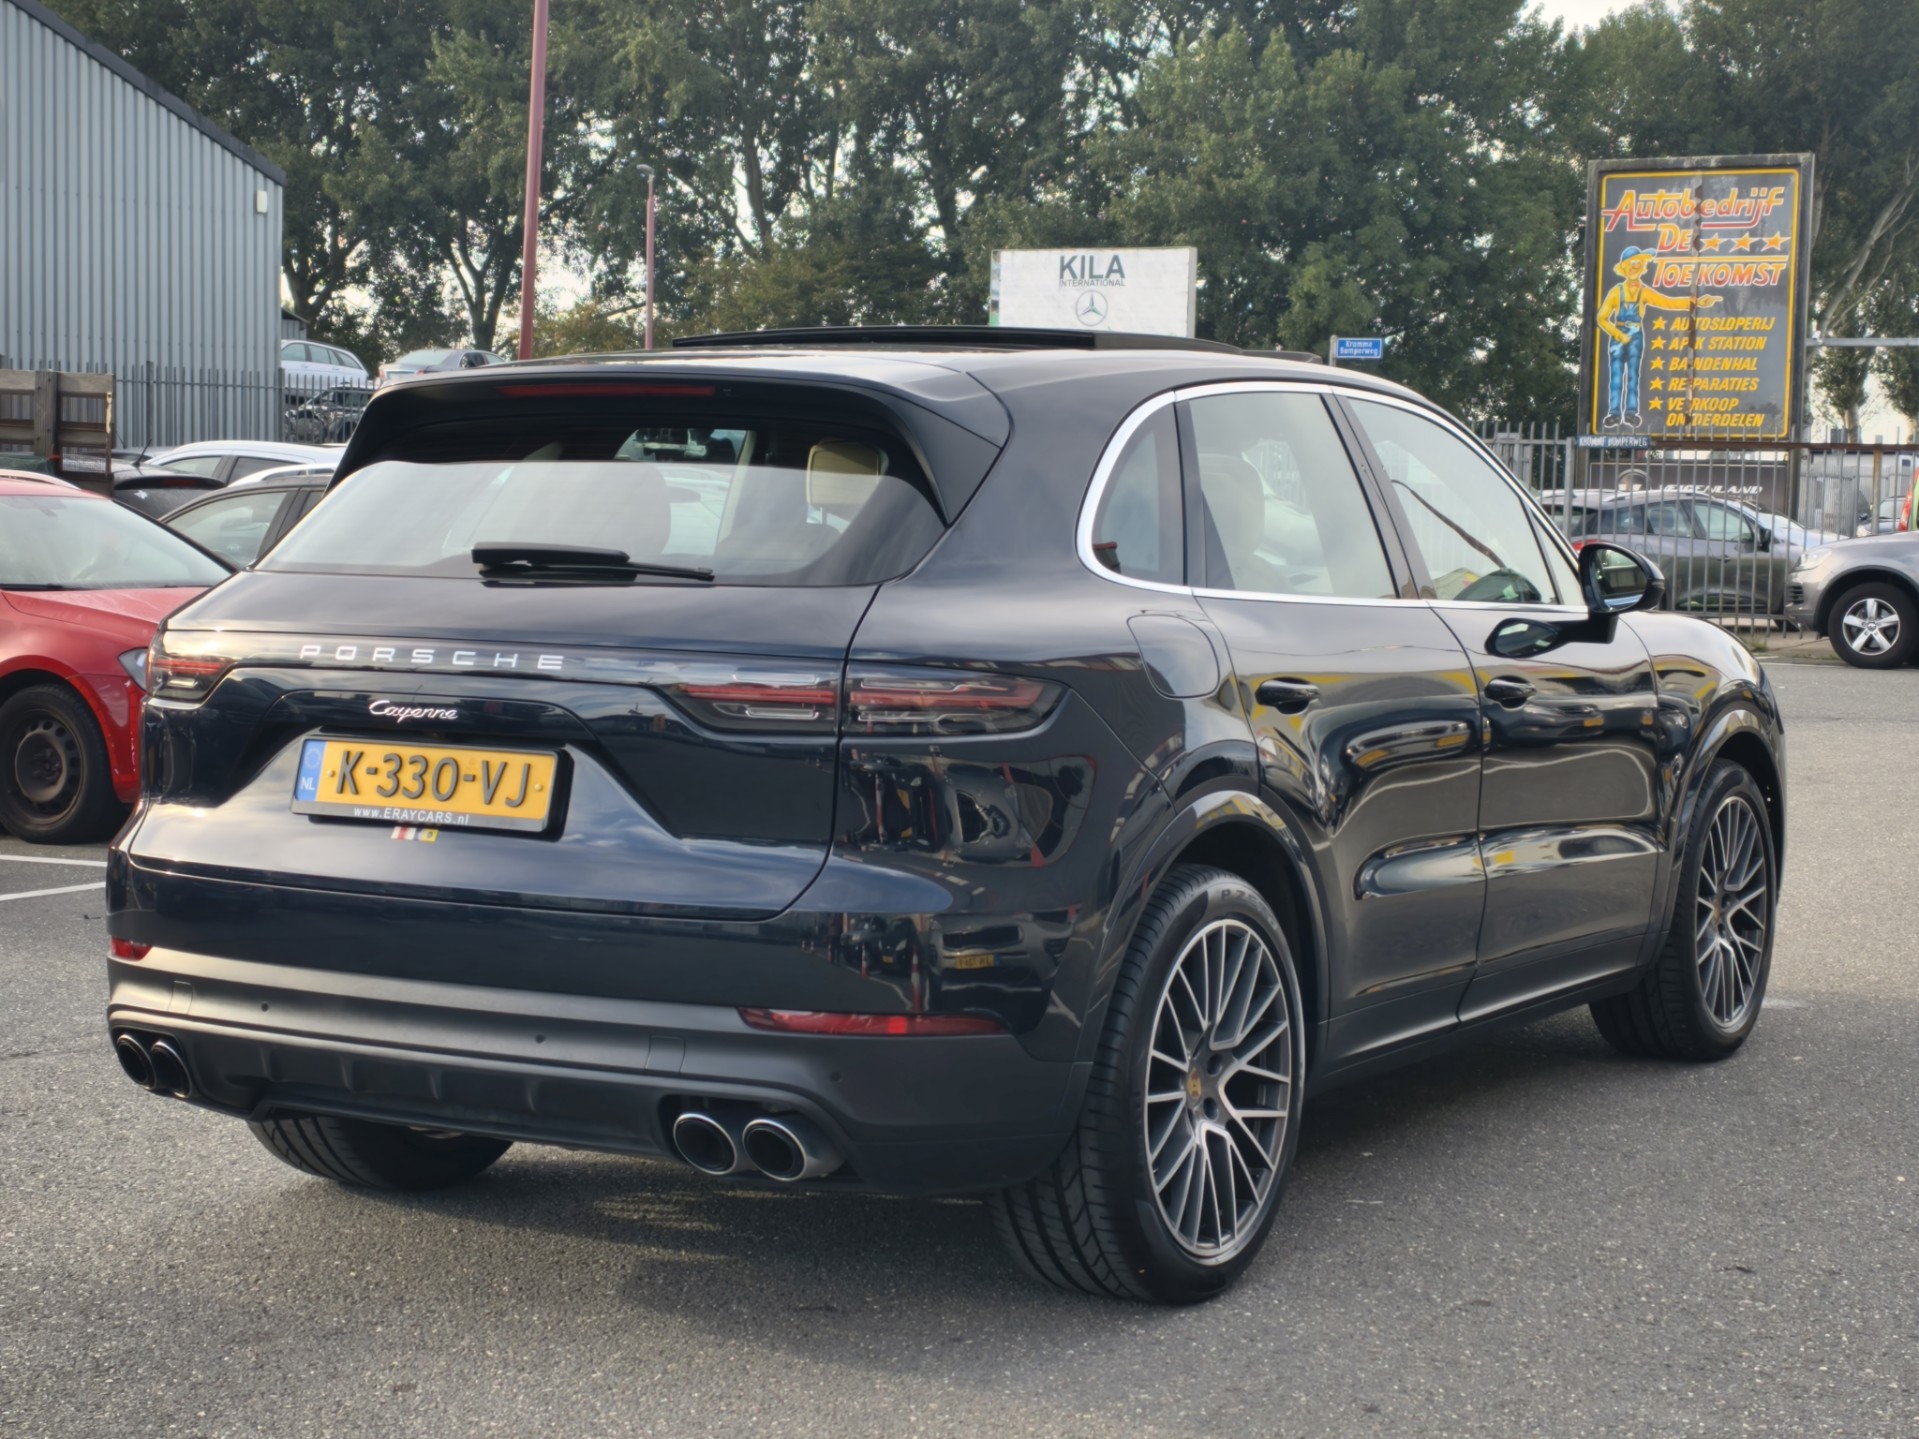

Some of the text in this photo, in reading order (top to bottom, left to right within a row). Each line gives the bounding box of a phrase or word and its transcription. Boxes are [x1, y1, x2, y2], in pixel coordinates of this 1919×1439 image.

[1601, 187, 1784, 232] Autobedrijf
[1059, 254, 1126, 280] KILA
[1652, 255, 1789, 288] TOEKOMST
[1059, 278, 1126, 288] INTERNATIONAL
[1670, 316, 1776, 331] AUTOSLOPERIJ
[1668, 336, 1767, 351] APK STATION
[1669, 356, 1758, 371] BANDENHAL
[1668, 377, 1759, 391] REPARATIES
[1667, 397, 1739, 411] VERKOOP
[1666, 412, 1765, 427] ONDERDELEN
[300, 645, 564, 670] PORSCHE
[368, 700, 459, 723] Cayenne
[300, 776, 316, 791] NL
[336, 750, 531, 808] K-330-VJ
[353, 807, 470, 826] www.ERAYCARS.nl
